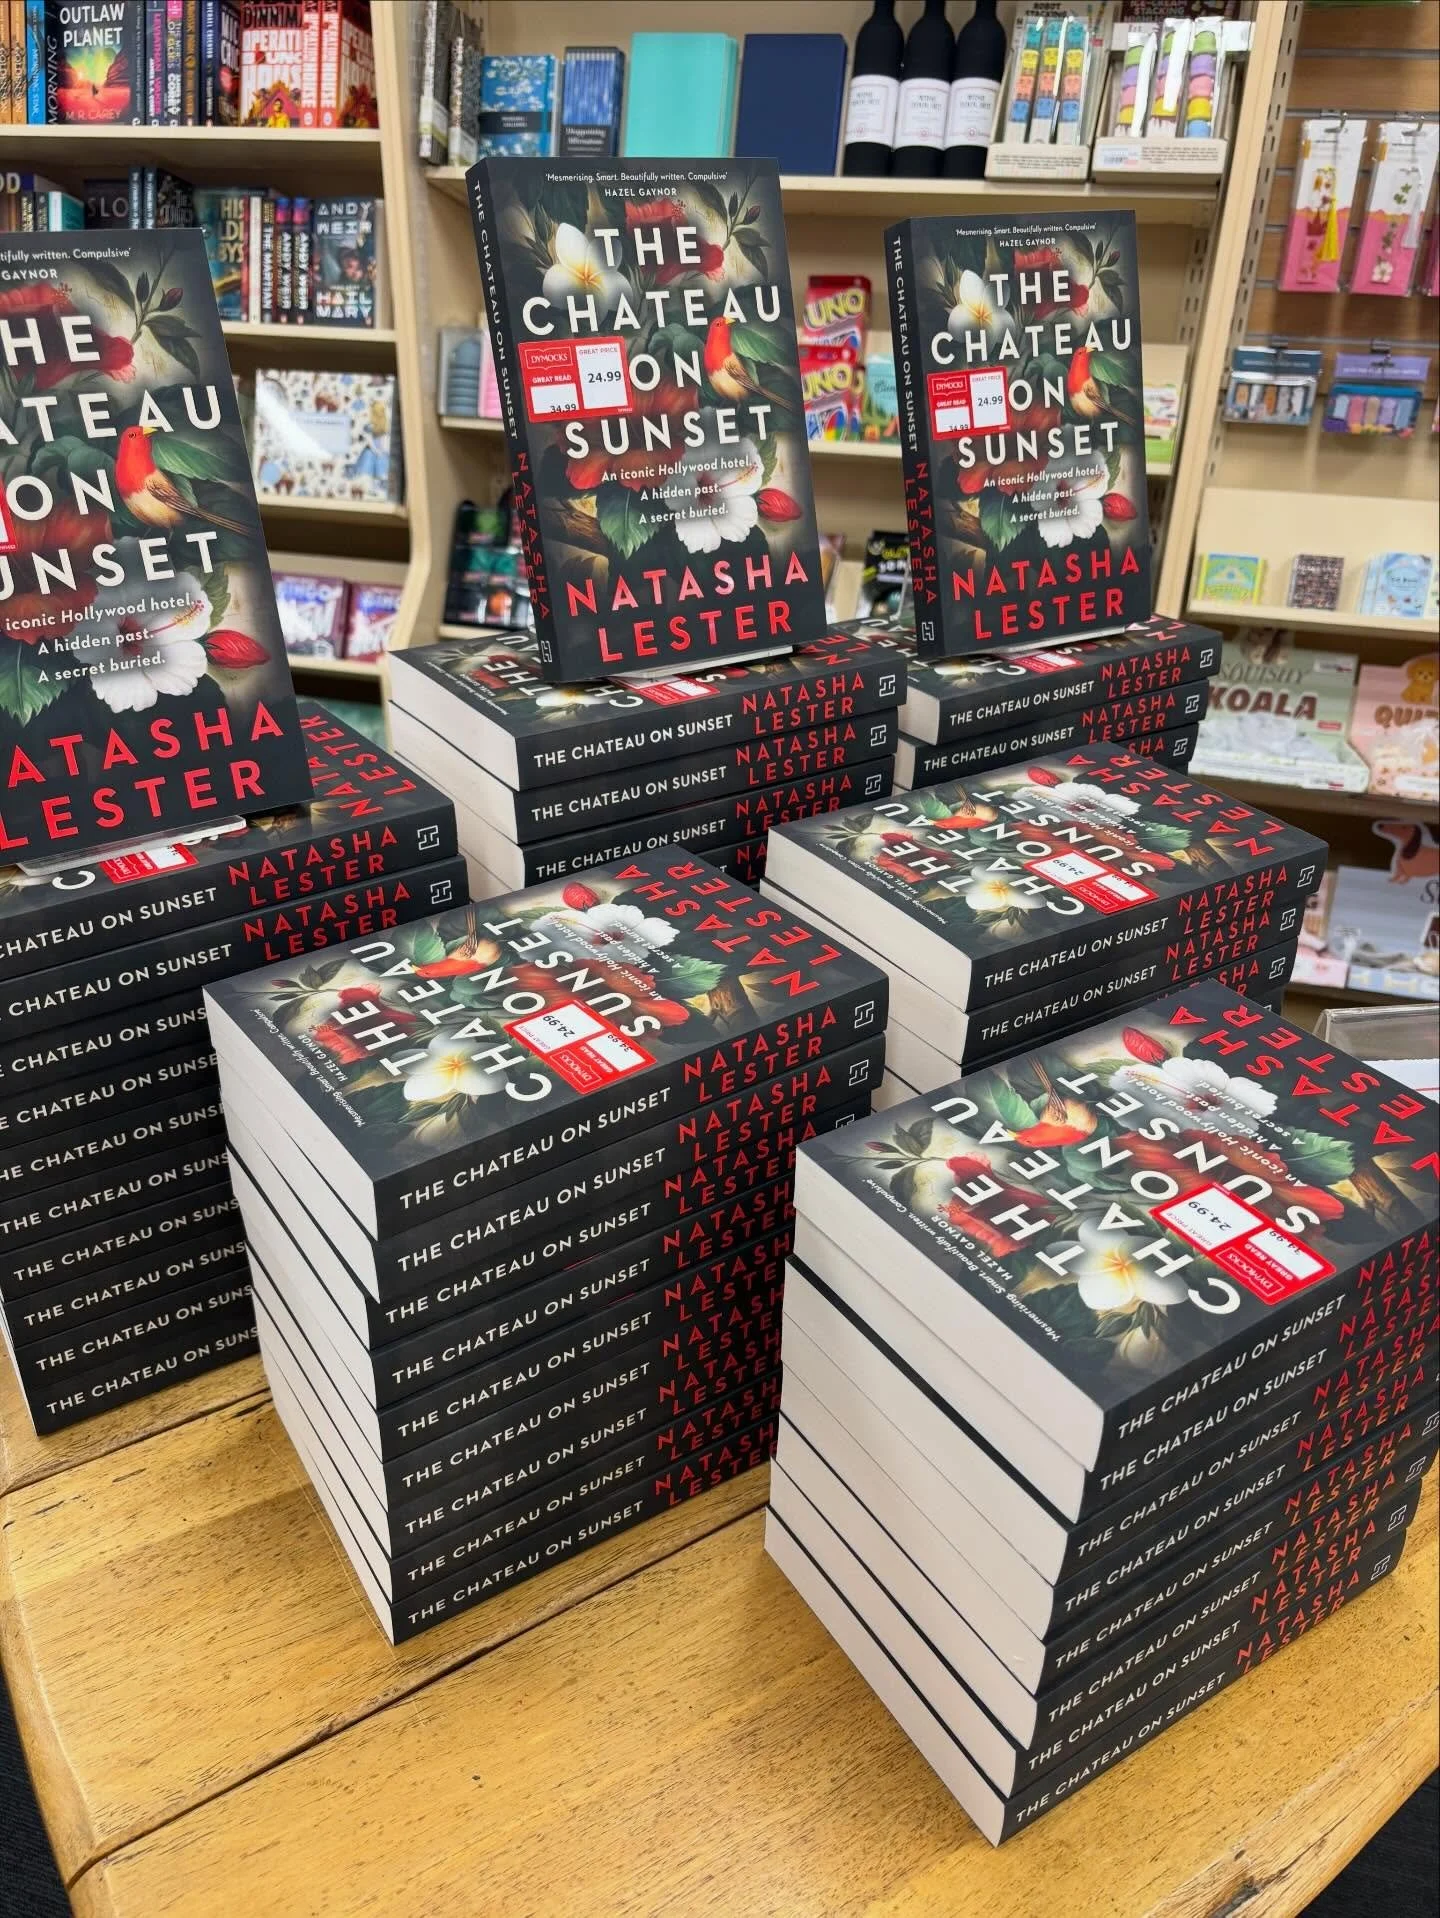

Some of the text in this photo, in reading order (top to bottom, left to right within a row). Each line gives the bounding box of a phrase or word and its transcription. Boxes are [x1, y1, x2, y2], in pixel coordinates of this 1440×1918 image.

[60, 3, 124, 24] OUTLAW
[63, 27, 123, 47] PLANET
[243, 30, 301, 51] OPERATI
[47, 35, 57, 125] MORNING
[595, 172, 618, 181] Smart.
[620, 172, 659, 183] Beautifully
[688, 171, 728, 183] Compulsive'
[605, 187, 677, 197] HAZEL GAYNOR
[317, 222, 371, 235] WEIR
[318, 202, 371, 219] ANDY
[32, 248, 132, 264] written. Compulsive'
[263, 226, 273, 309] THE MARTIAN
[594, 226, 701, 267] THE
[1000, 238, 1056, 248] HAZEL GAYNOR
[1, 268, 58, 281] GAYNOR
[281, 232, 291, 309] ANDY WEIR
[299, 232, 308, 309] ANDY WEIR
[989, 270, 1071, 306] THE
[316, 292, 371, 304] HAIL
[316, 305, 371, 318] MARY
[474, 180, 518, 440] THE CHATEAU ON SUNSET
[522, 285, 781, 336] CHATEAU
[805, 288, 865, 328] UNO
[0, 315, 101, 366] HE
[531, 353, 568, 364] DYMOCKS
[931, 319, 1131, 365] CHATEAU
[532, 374, 572, 384] GREAT READ
[588, 371, 622, 383] 24.99
[629, 351, 702, 392] ON
[802, 362, 852, 400] UNO
[1008, 376, 1065, 411] ON
[0, 385, 222, 445] TEAU
[977, 396, 1003, 406] 24.99
[565, 405, 772, 459] SUNSET
[958, 421, 1119, 468] SUNSET
[601, 456, 752, 482] An iconic Hollywood hotel.
[652, 483, 722, 501] hidden past.
[1027, 468, 1074, 483] Hollywood
[6, 469, 116, 521] ON
[651, 504, 728, 524] secret buried.
[1049, 505, 1080, 518] buried.
[511, 472, 539, 603] LESTER
[518, 452, 550, 619] NATASHA
[0, 531, 217, 601] NSET
[567, 552, 808, 617] NATASHA
[953, 547, 1139, 600] NATASHA
[5, 592, 196, 632] iconic Hollywood hotel.
[599, 601, 791, 663] LESTER
[975, 588, 1124, 639] LESTER
[54, 628, 154, 654] hidden past.
[1102, 646, 1191, 679] NATASHA
[55, 652, 166, 682] secret buried.
[1107, 668, 1182, 699] LESTER
[742, 672, 865, 715] NATASHA
[755, 697, 855, 736] LESTER
[949, 680, 1095, 727] THE CHATEAU ON SUNSET
[1208, 685, 1318, 721] KOALA
[7, 701, 285, 789] ATASHA
[534, 714, 734, 768] THE CHATEAU ON SUNSET
[0, 760, 266, 850] LESTER
[1066, 754, 1274, 856] NATASHA
[1110, 754, 1285, 836] LESTER
[972, 790, 1155, 877] SUNSET
[981, 823, 1052, 857] ON
[873, 803, 1085, 916] CHATEAU
[882, 841, 975, 894] THE
[243, 882, 412, 943] NATASHA
[665, 861, 842, 967] LESTER
[1178, 865, 1288, 915] NATASHA
[1184, 890, 1274, 935] LESTER
[264, 908, 398, 961] LESTER
[615, 864, 820, 997] NATASHA
[984, 917, 1169, 988] THE CHATEAU ON SUNSET
[8, 943, 233, 1016] CHATEAU ON SUNSET
[470, 967, 546, 1016] ON
[483, 918, 661, 1040] SUNSET
[332, 1001, 428, 1077] THE
[350, 940, 552, 1102] CHATEAU
[543, 1015, 575, 1038] 24.99
[683, 1005, 838, 1085] NATASHA
[560, 1054, 592, 1081] DYMOCKS
[699, 1036, 822, 1104] LESTER
[1221, 1004, 1426, 1120] ESTER
[400, 1087, 671, 1209] THE CHATEAU ON SUNSET
[1056, 1072, 1320, 1234] SUNSET
[1078, 1135, 1179, 1201] ON
[931, 1097, 1241, 1315] CHATEAU
[952, 1174, 1085, 1276] THE
[1188, 1200, 1232, 1231] 24.99
[931, 1214, 1013, 1281] HAZEL GAYNOR
[1229, 1252, 1273, 1289] DYMOCKS
[1118, 1294, 1345, 1440] THE CHATEAU ON SUNSET
